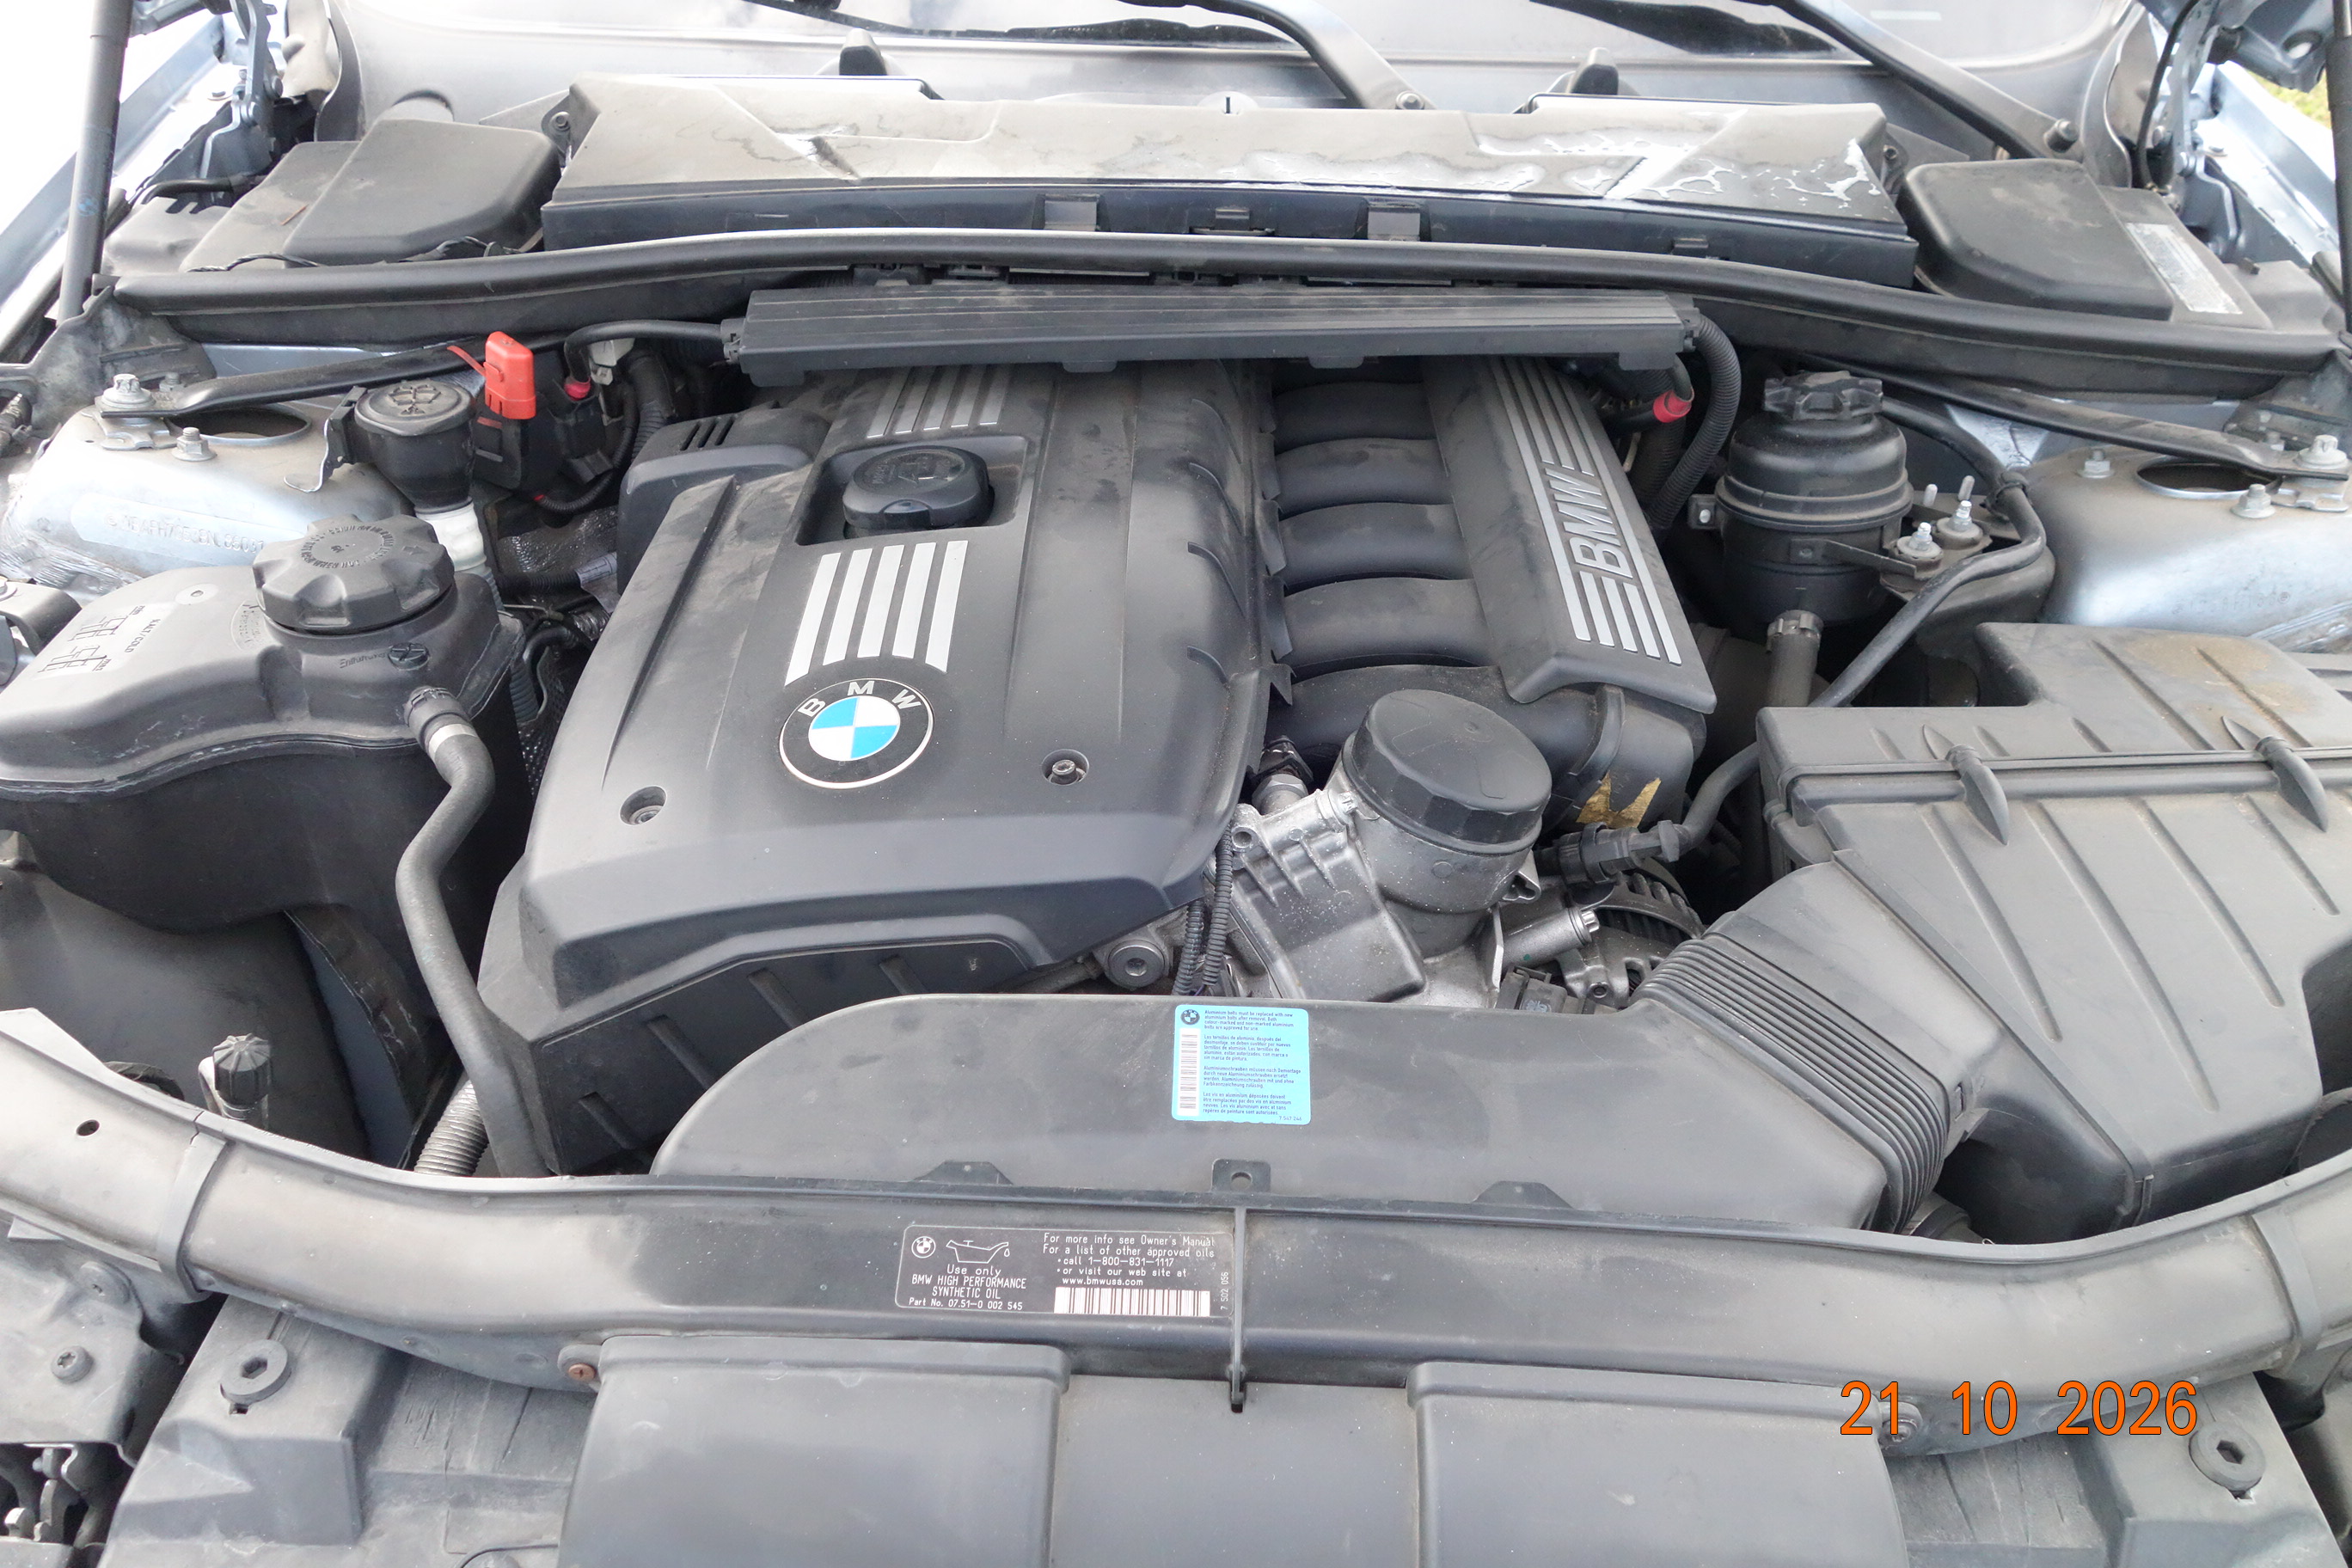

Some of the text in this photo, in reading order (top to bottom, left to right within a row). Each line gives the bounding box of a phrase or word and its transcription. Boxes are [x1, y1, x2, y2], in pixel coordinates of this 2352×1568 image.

[1546, 468, 1633, 579] BMW
[798, 681, 922, 717] BMW
[1044, 1233, 1059, 1243] For
[1094, 1234, 1112, 1244] info
[1142, 1234, 1176, 1245] Owner's
[1183, 1236, 1214, 1246] Manual
[1044, 1243, 1059, 1253] For
[1076, 1245, 1093, 1254] list
[1099, 1245, 1110, 1254] of
[1116, 1246, 1141, 1256] other
[1147, 1248, 1190, 1258] approved
[1196, 1247, 1215, 1258] oils
[1088, 1257, 1174, 1266] 1-800-831-1117
[946, 1264, 1001, 1278] Use only
[1079, 1266, 1100, 1275] visit
[1129, 1267, 1146, 1276] web
[1177, 1268, 1186, 1277] at
[912, 1274, 1026, 1289] BMW HIGH PERFORMANCE
[1063, 1276, 1143, 1285] www.bmwusa.com
[932, 1286, 1001, 1299] SYNTHETIC OIL
[910, 1297, 1023, 1310] Part No. 07.51-0 002 545
